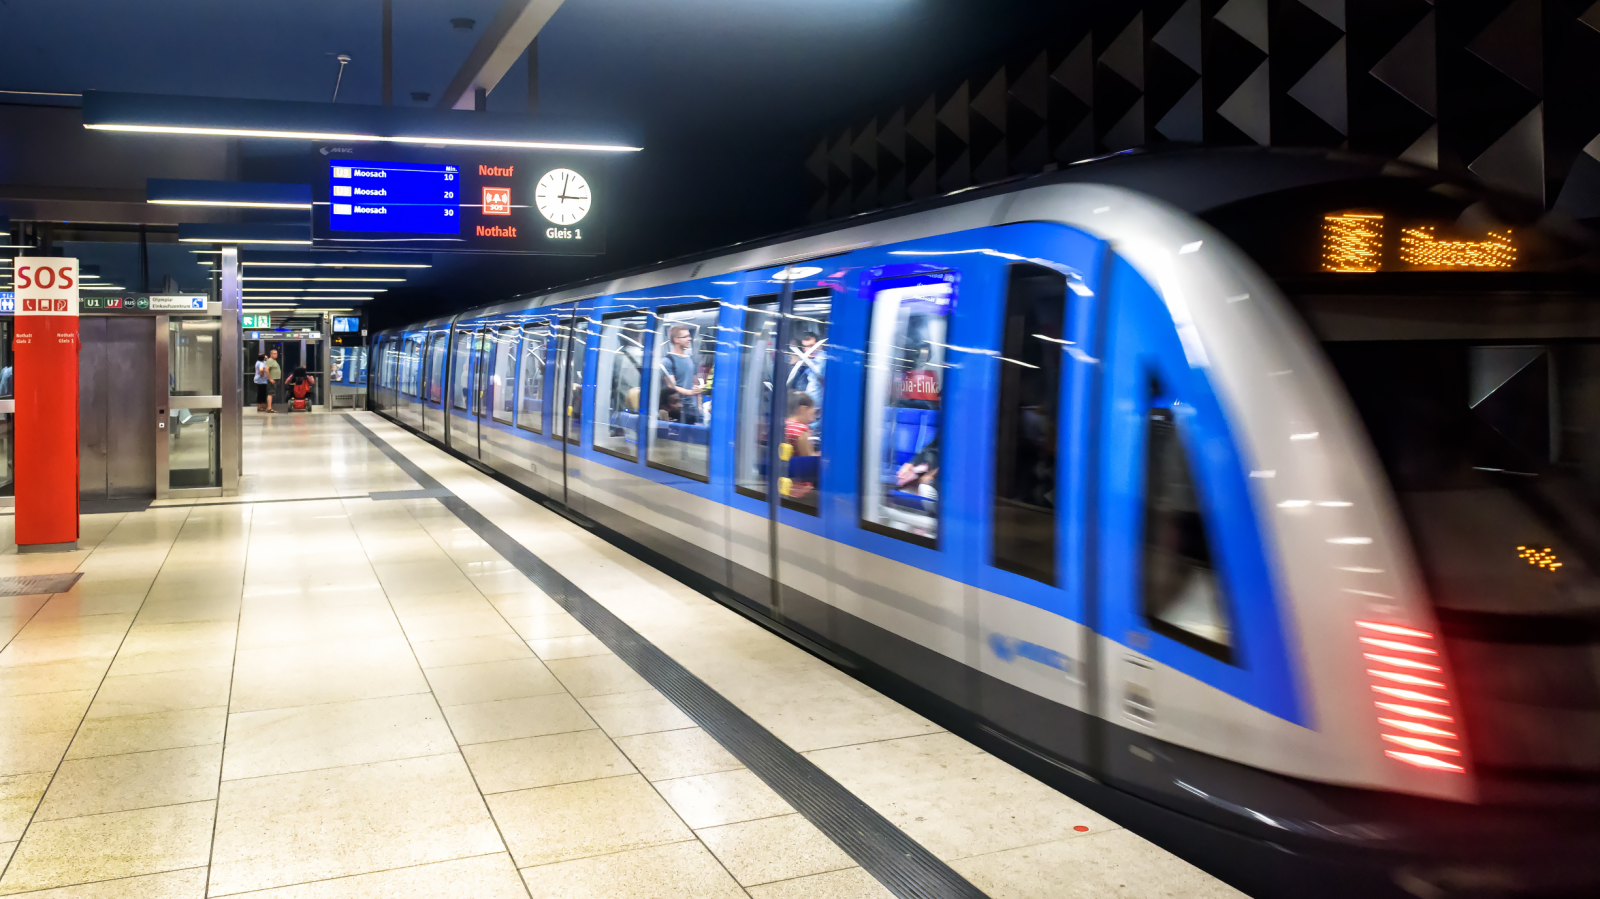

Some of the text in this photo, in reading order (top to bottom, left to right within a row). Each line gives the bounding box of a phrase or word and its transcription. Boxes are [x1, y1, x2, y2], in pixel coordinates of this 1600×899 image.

[354, 169, 387, 178] Moosach
[444, 173, 454, 181] 10
[478, 164, 514, 177] Notruf
[354, 187, 387, 196] Moosach
[444, 191, 454, 199] 20
[354, 205, 387, 214] Moosach
[476, 225, 517, 238] Nothalt
[546, 228, 582, 239] Gleis 1
[17, 266, 74, 289] SOS
[87, 299, 100, 307] U1
[107, 299, 120, 307] U7
